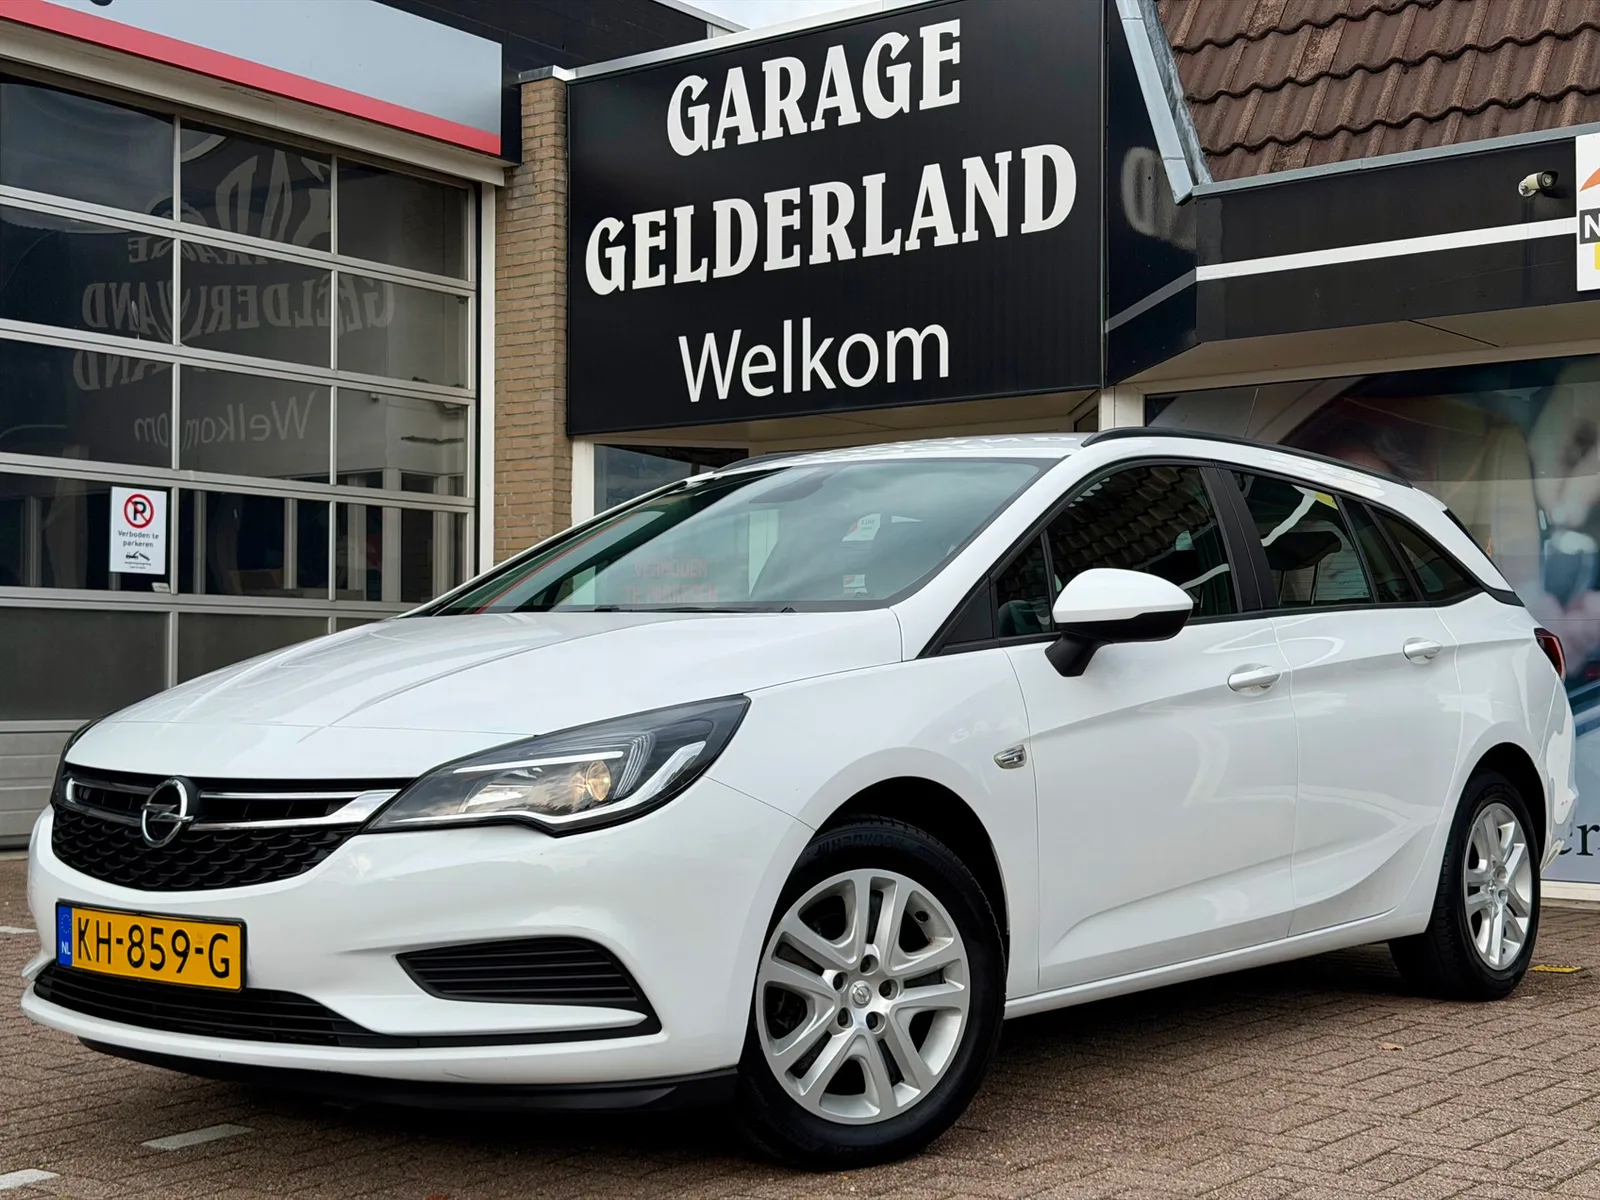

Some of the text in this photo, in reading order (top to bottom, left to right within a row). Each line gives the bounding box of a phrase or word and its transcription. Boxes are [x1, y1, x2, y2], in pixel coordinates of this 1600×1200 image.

[667, 18, 961, 156] GARAGE
[585, 144, 1077, 296] GELDERLAND
[678, 317, 949, 402] Welkom
[118, 530, 150, 539] Verboden
[122, 540, 153, 548] parkeren
[62, 917, 230, 979] NL KH-859-G
